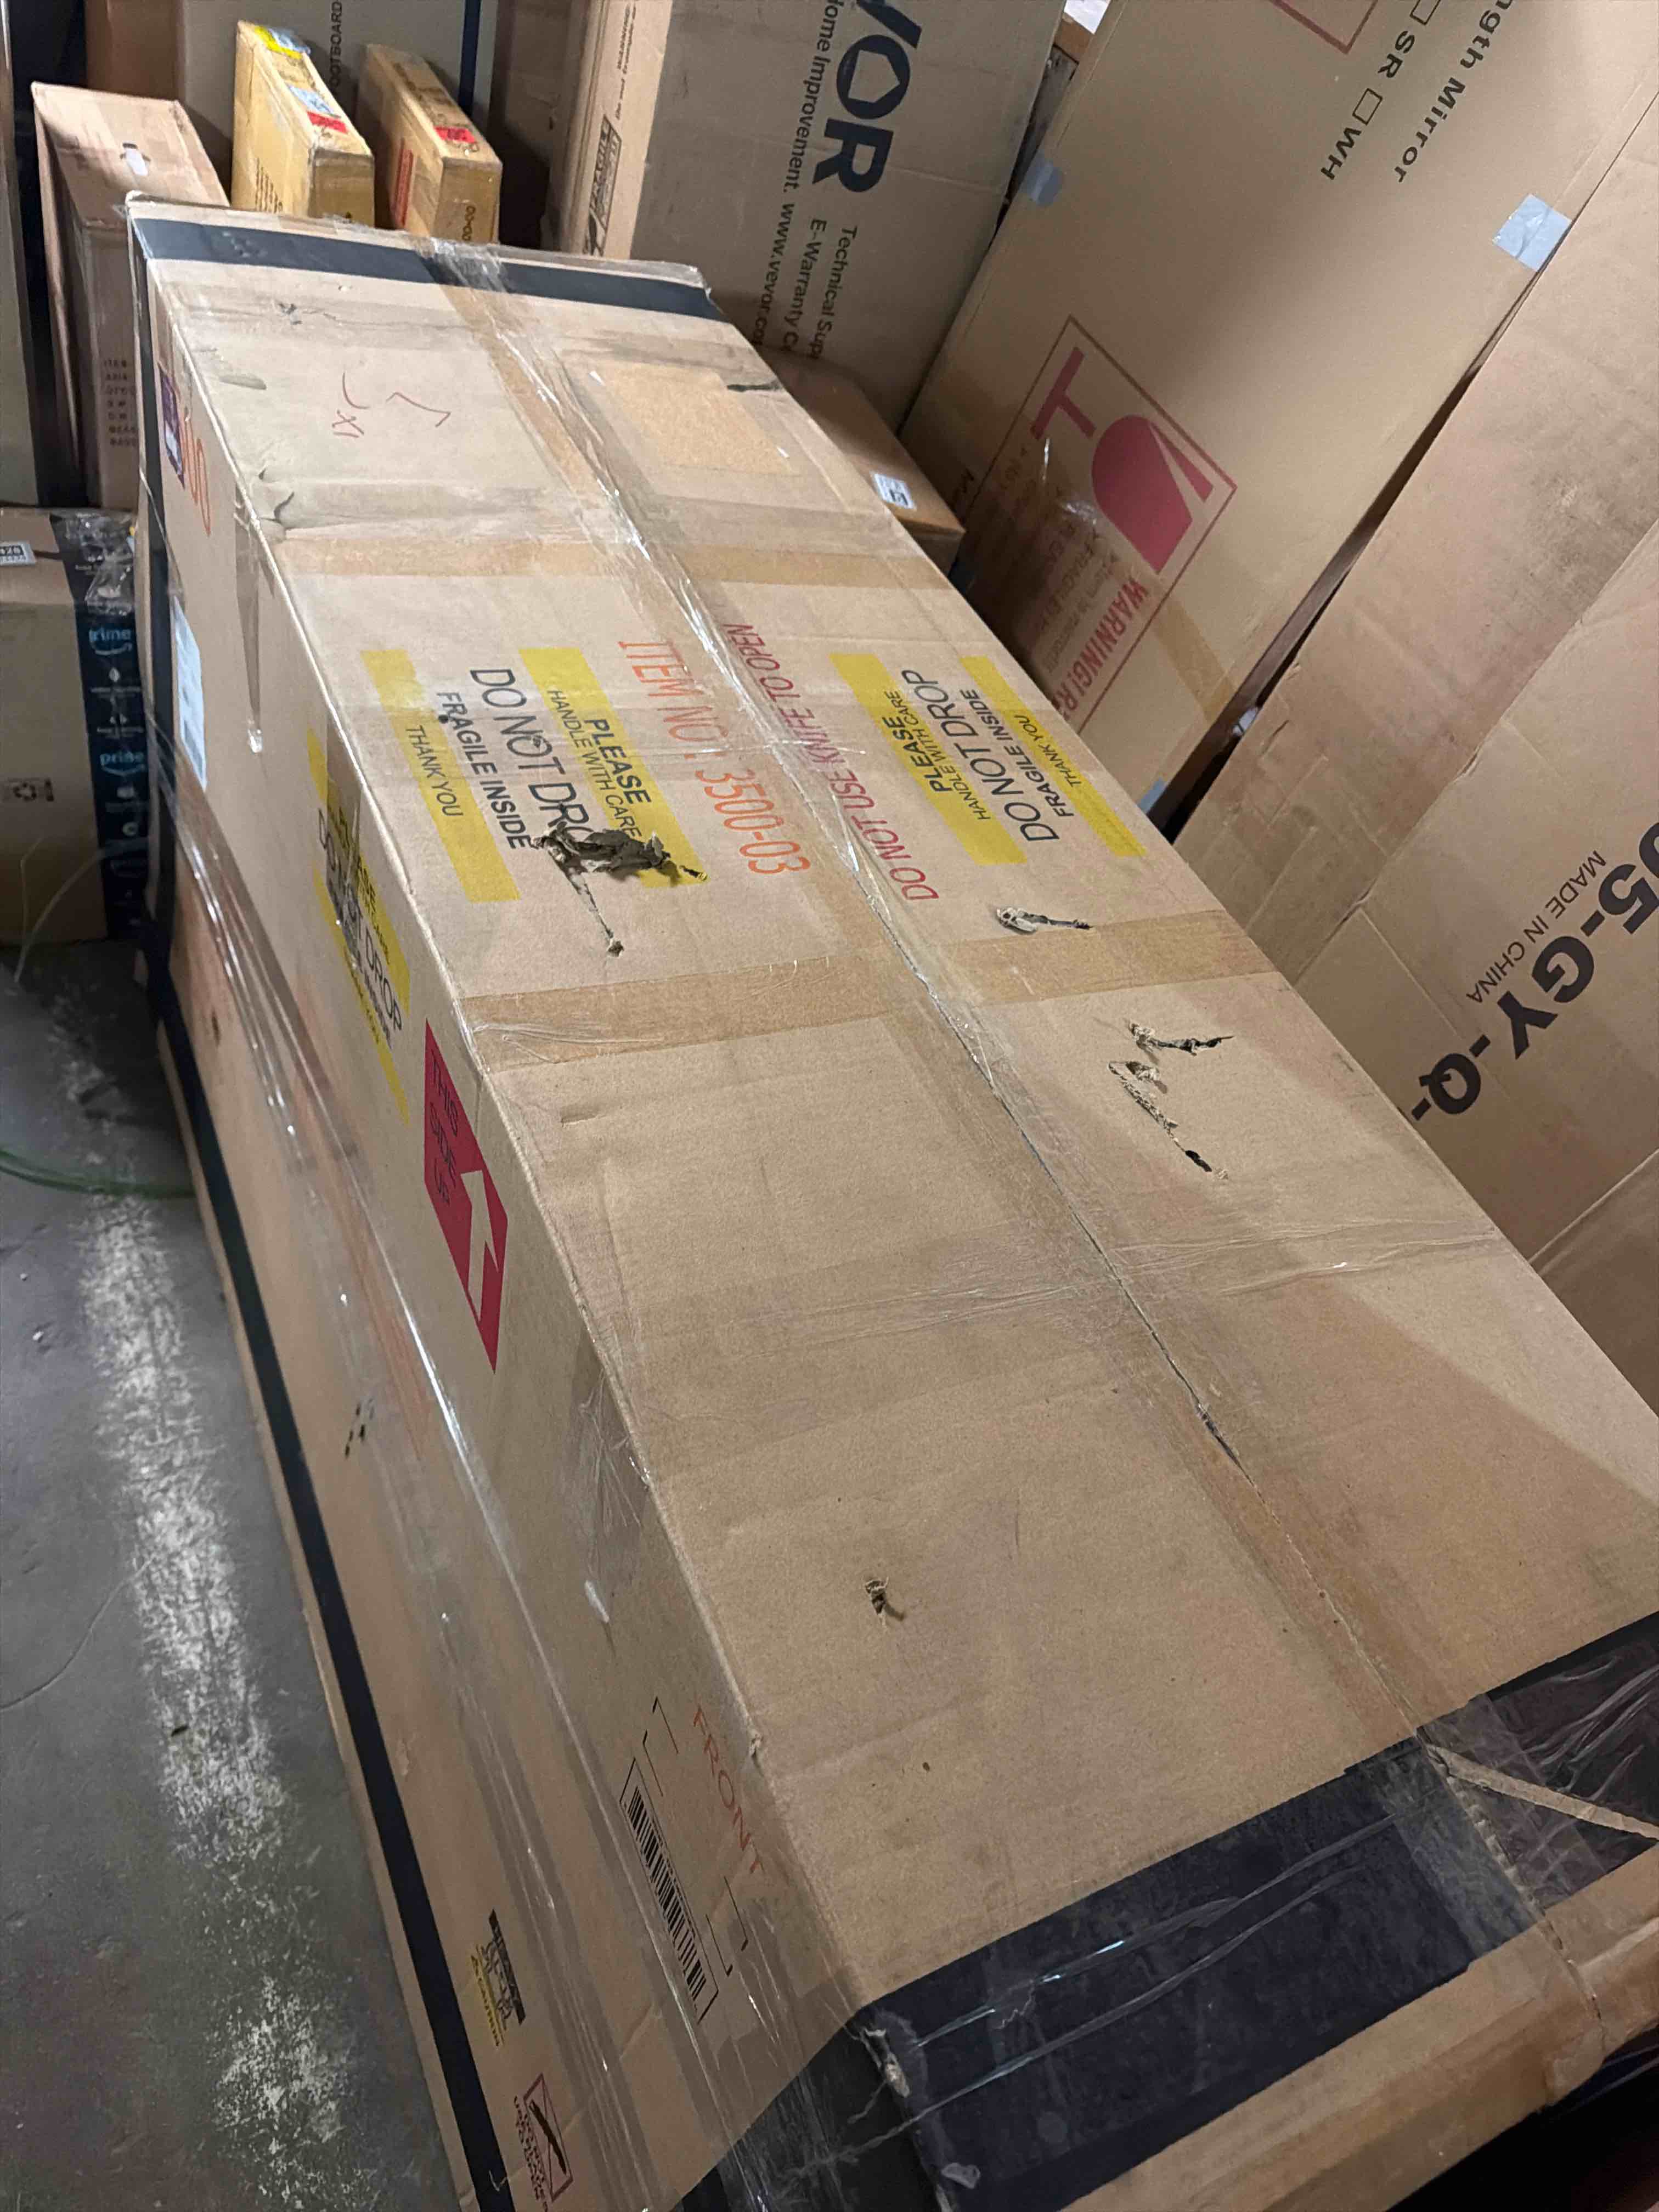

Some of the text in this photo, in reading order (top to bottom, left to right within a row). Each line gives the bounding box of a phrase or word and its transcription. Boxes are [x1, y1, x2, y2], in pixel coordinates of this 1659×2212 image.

[783, 55, 831, 193] Improvement.
[1321, 30, 1415, 180] SR WH
[1395, 77, 1466, 182] Mirror
[784, 218, 827, 328] E-Warranty
[822, 225, 857, 317] Technical
[470, 669, 527, 708] DO
[1067, 576, 1149, 697] WARNING!
[406, 725, 464, 816] THANK YOU
[437, 692, 535, 849] FRAGILE INSIDE
[493, 715, 566, 775] NOT
[547, 690, 642, 838] HANDLE WITH CARE
[583, 719, 652, 804] PLEASE
[618, 640, 704, 697] ITEM
[695, 769, 811, 875] 3500-03
[721, 624, 939, 900] DO NOT USE KNIFE TO OPEN
[882, 716, 952, 793] PLEASE
[884, 690, 991, 820] HANDLE WITH CARE
[901, 670, 1059, 841] DO NOT DROP
[960, 689, 1075, 817] FRAGILE INSIDE
[1014, 714, 1082, 787] THANK YOU
[366, 926, 402, 1032] DROP
[1466, 850, 1607, 1003] MADE IN CHINA
[693, 1705, 766, 1875] FRONT
